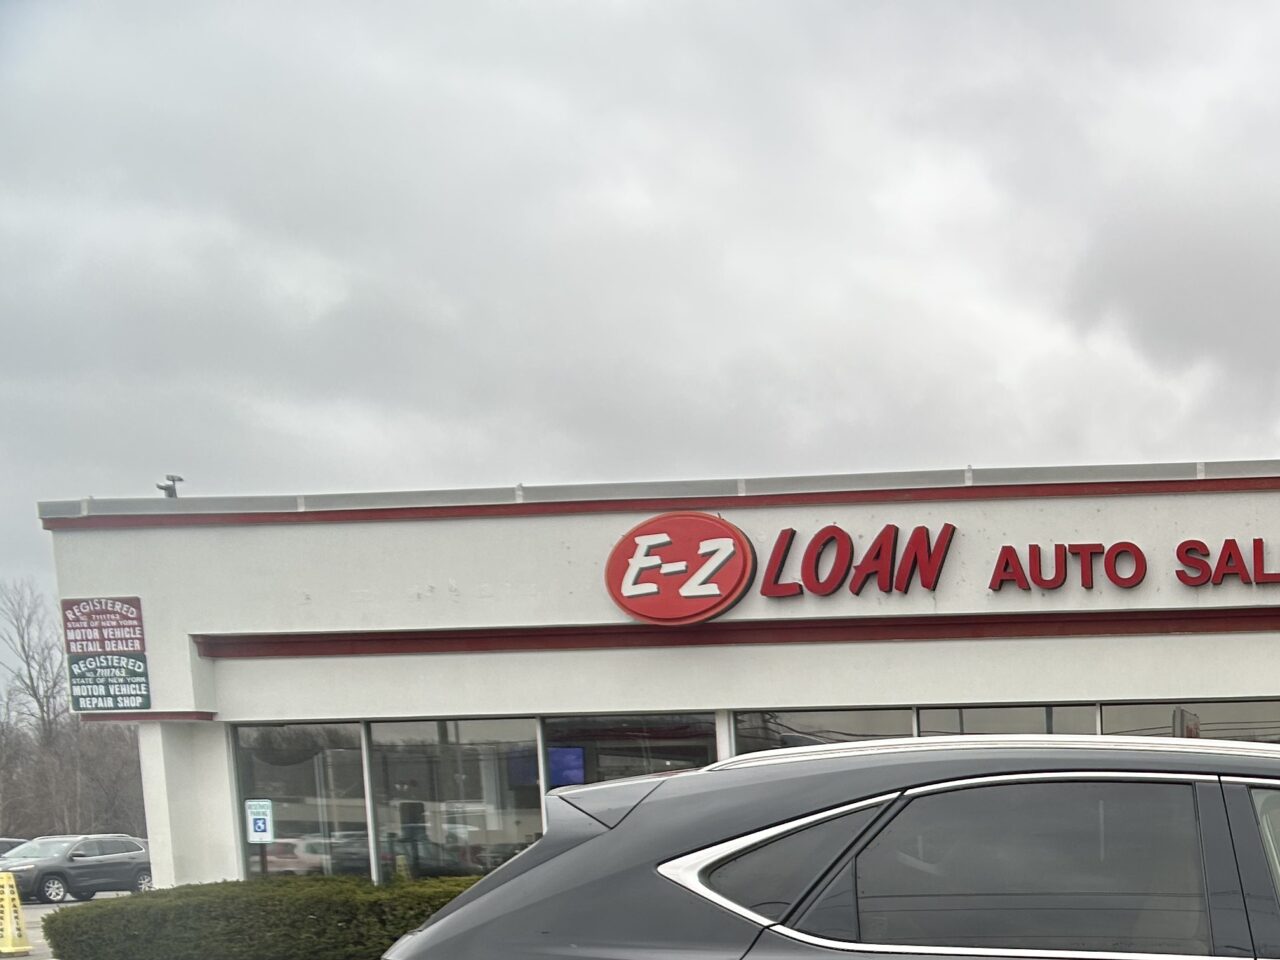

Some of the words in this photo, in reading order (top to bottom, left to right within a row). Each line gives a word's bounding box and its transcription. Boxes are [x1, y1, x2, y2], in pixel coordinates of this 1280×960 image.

[621, 532, 736, 597] E-Z
[760, 522, 957, 597] LOAN
[988, 542, 1148, 590] AUTO
[65, 599, 137, 620] REGISTERED
[67, 628, 99, 640] MOTOR
[102, 627, 142, 639] VEHICLE
[70, 641, 102, 652] RETAIL
[104, 640, 141, 651] DEALER
[71, 655, 144, 676] REGISTERED
[72, 684, 105, 696] MOTOR
[109, 683, 148, 695] VEHICLE
[79, 697, 114, 708] REPAIR
[117, 696, 142, 708] SHOP
